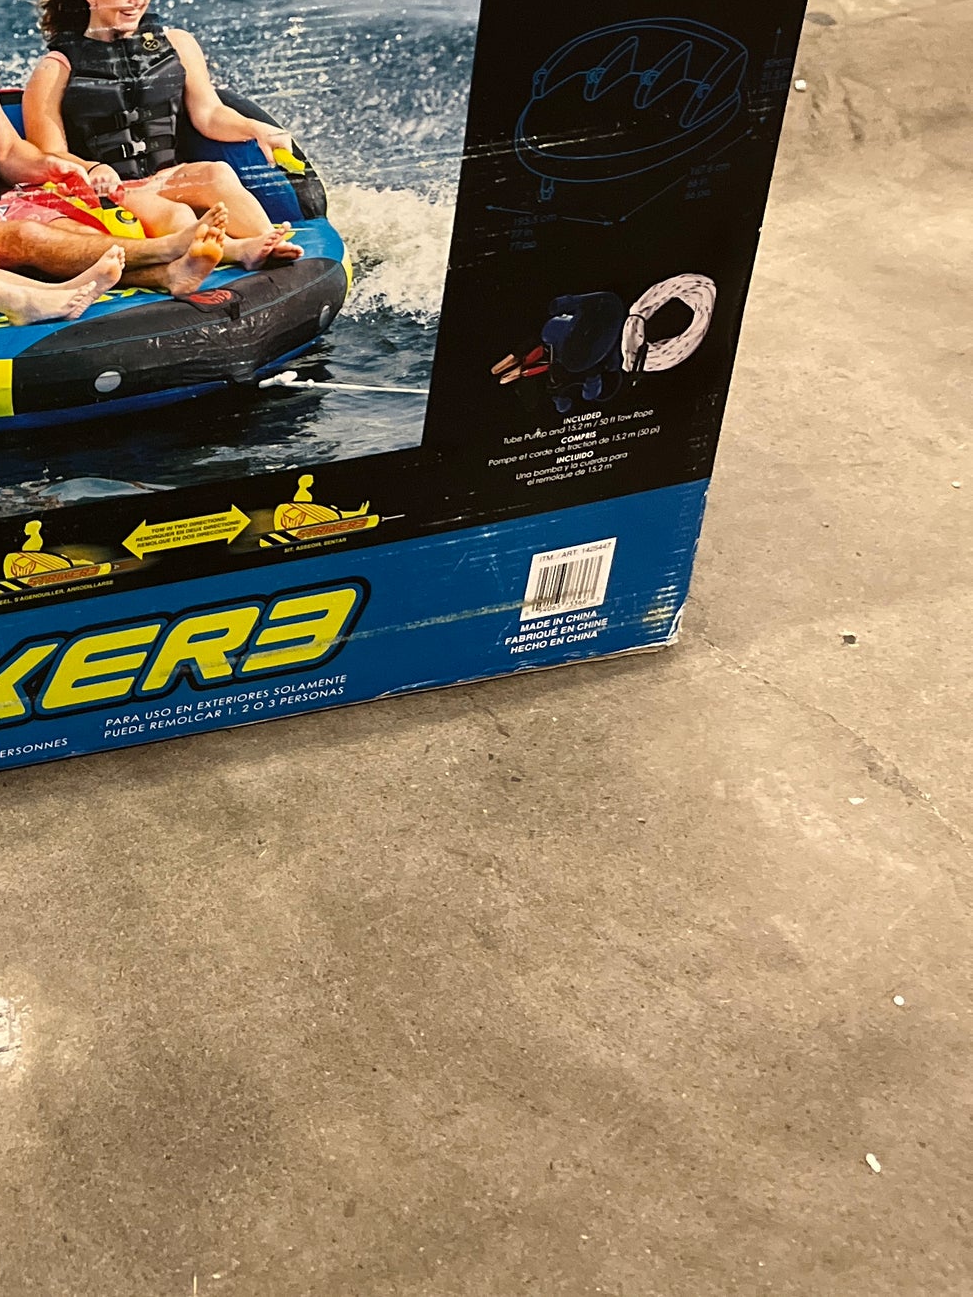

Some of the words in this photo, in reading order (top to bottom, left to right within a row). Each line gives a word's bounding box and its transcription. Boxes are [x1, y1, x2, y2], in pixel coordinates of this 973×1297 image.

[503, 436, 523, 445] Tube
[549, 426, 566, 436] and
[568, 422, 583, 432] 15.2
[599, 417, 609, 426] 50
[617, 414, 632, 422] Tow
[633, 409, 654, 419] Rope
[563, 411, 602, 425] INCLUDED
[561, 431, 597, 444] COMPRIS
[488, 456, 518, 467] Pompe
[529, 449, 553, 459] corde
[554, 446, 566, 454] de
[567, 440, 598, 451] traction
[598, 437, 610, 445] de
[612, 432, 627, 441] 15.2
[556, 450, 594, 464] INCLUIDO
[515, 471, 532, 480] Una
[533, 466, 563, 477] bomba
[579, 456, 608, 467] cuerda
[609, 452, 628, 462] para
[527, 478, 535, 486] el
[535, 471, 574, 484] remolque
[135, 531, 175, 542] REMORQUER
[136, 537, 172, 548] REMOLQUE
[67, 579, 114, 592] ARRODILLARSE
[504, 626, 559, 646] FABRIQUÉ
[560, 624, 575, 635] EN
[576, 617, 609, 631] CHINE
[520, 619, 551, 633] MADE
[552, 616, 564, 626] IN
[565, 610, 598, 623] CHINA
[510, 640, 548, 654] HECHO
[549, 636, 565, 646] EN
[566, 630, 598, 643] CHINA
[105, 713, 140, 727] PARA
[144, 707, 172, 720] USO
[176, 703, 194, 715] EN
[196, 690, 270, 710] EXTERIORES
[273, 674, 348, 695] SOLAMENTE
[103, 723, 146, 739] PUEDE
[149, 709, 222, 730] REMOLCAR
[241, 703, 250, 713] 2
[252, 701, 265, 711] O
[267, 698, 276, 708] 3
[279, 686, 345, 706] PERSONAS
